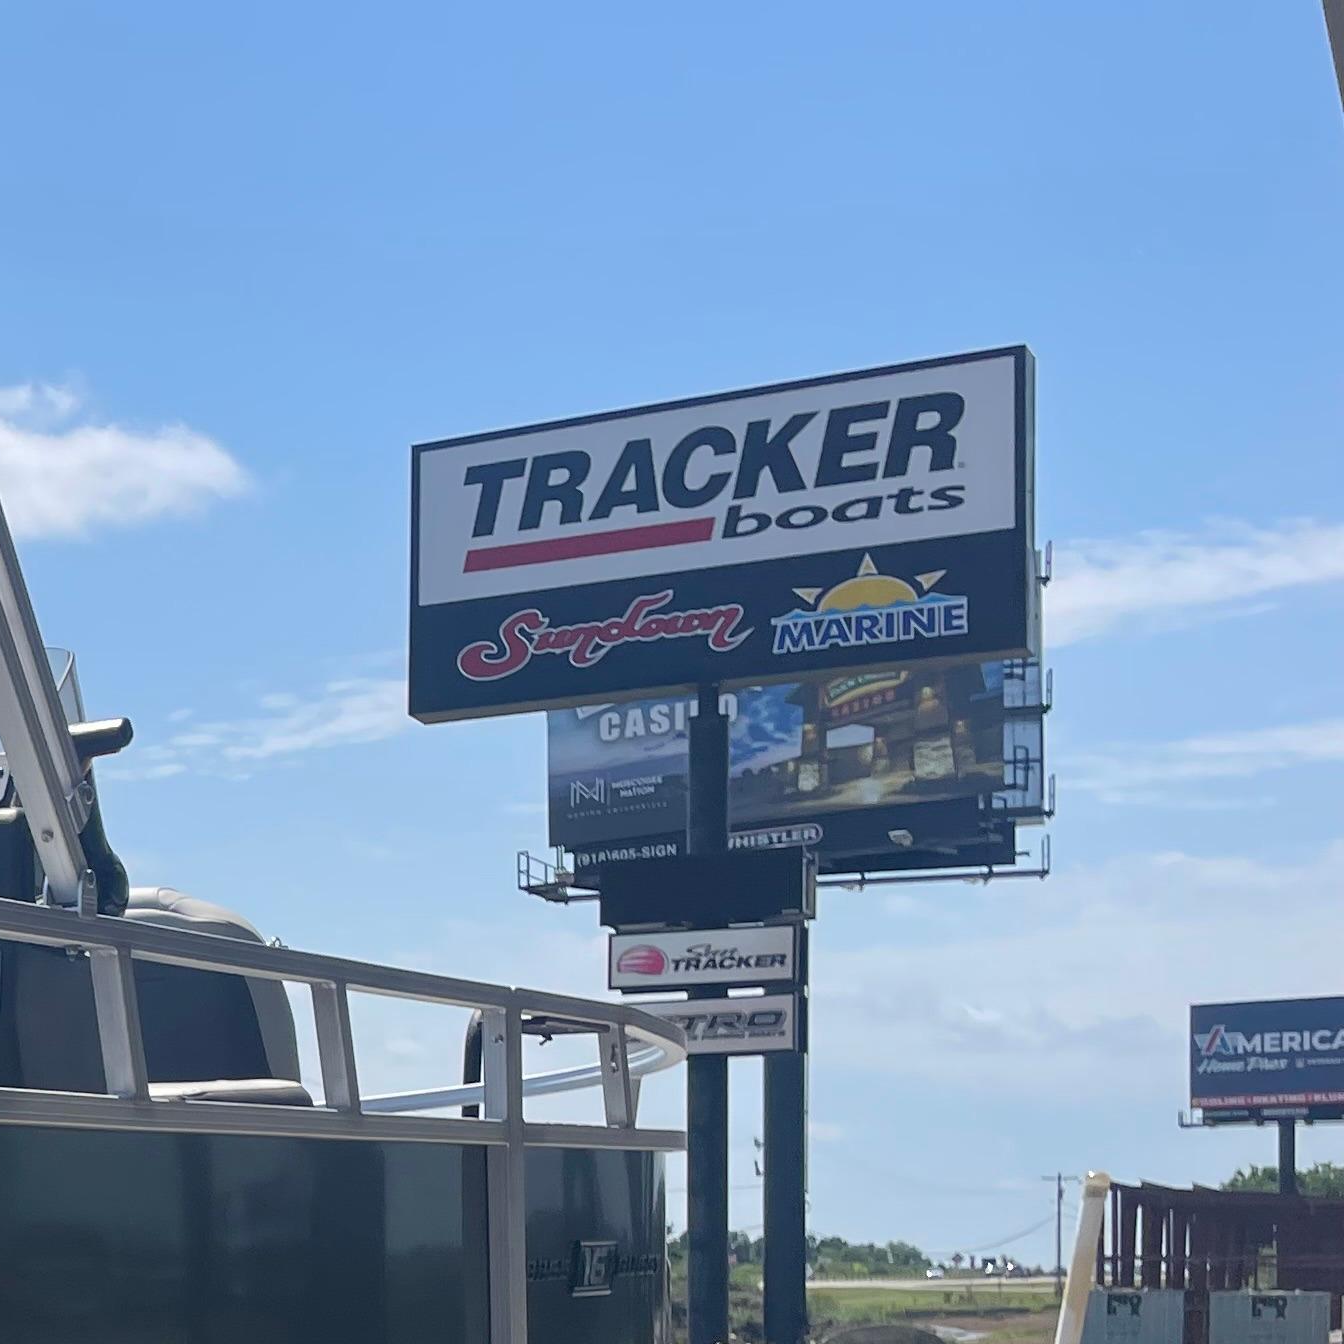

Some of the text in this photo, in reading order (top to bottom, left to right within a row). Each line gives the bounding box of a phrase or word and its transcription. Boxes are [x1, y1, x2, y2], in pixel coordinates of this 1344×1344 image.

[463, 391, 965, 538] TRACKER
[722, 485, 965, 539] boats
[457, 589, 968, 681] Sundown MARINE
[599, 693, 738, 741] CASIO
[671, 953, 787, 971] TRACKER
